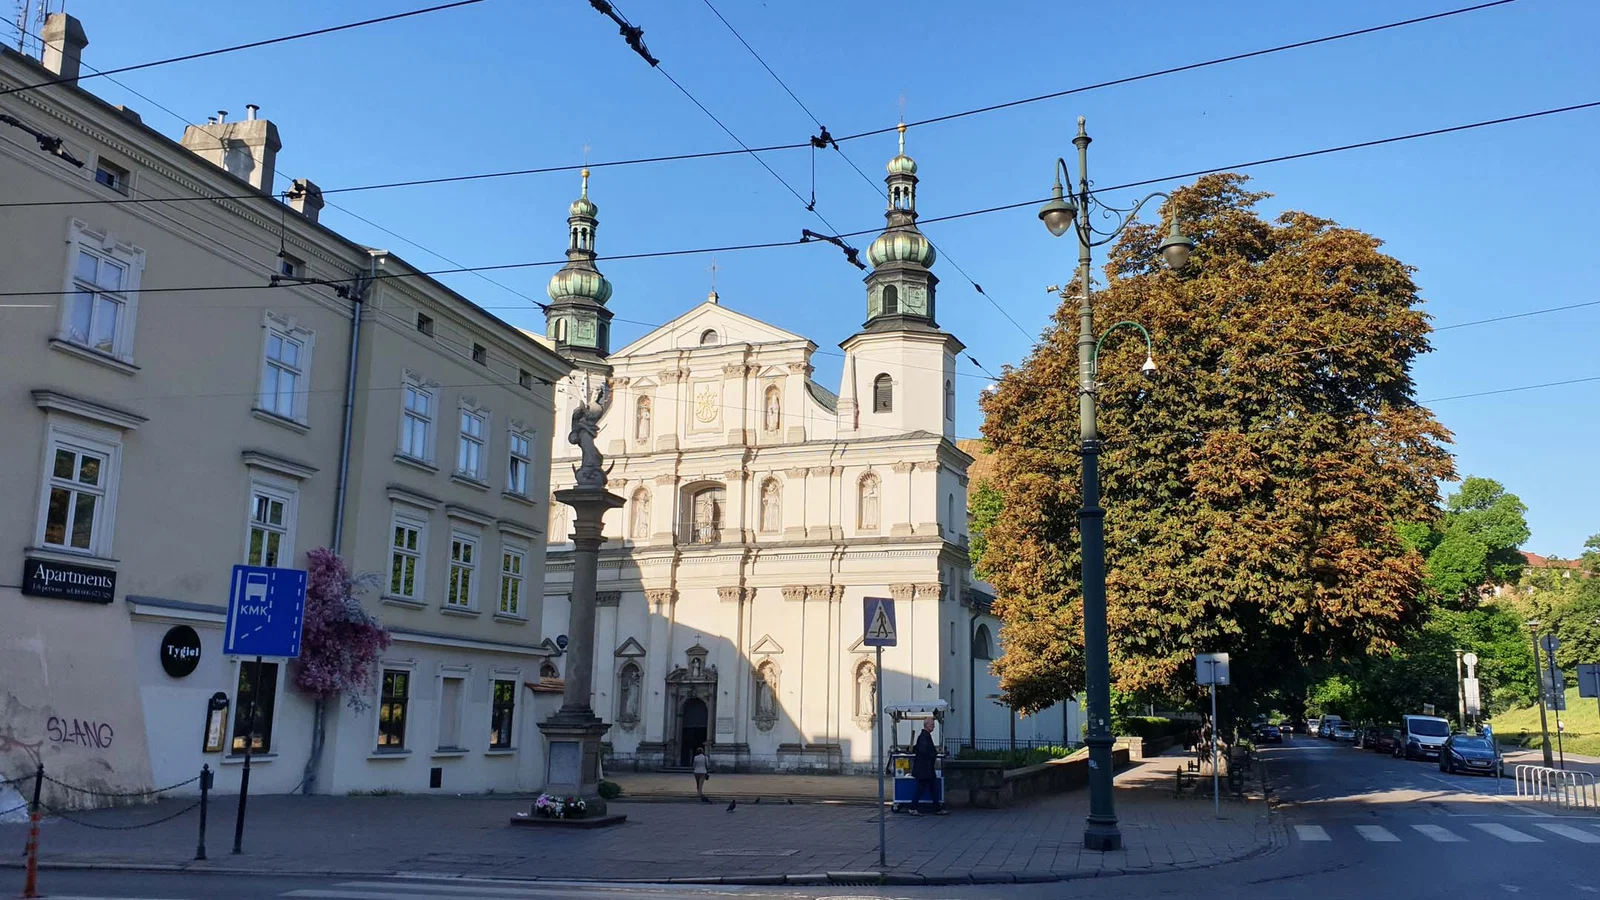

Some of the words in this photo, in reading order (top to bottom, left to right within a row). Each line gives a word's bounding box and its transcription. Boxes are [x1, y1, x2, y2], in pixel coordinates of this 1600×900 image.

[33, 564, 113, 588] Apartments
[240, 604, 268, 616] KMK
[167, 644, 200, 658] Tygiel
[47, 716, 114, 749] SLANG
